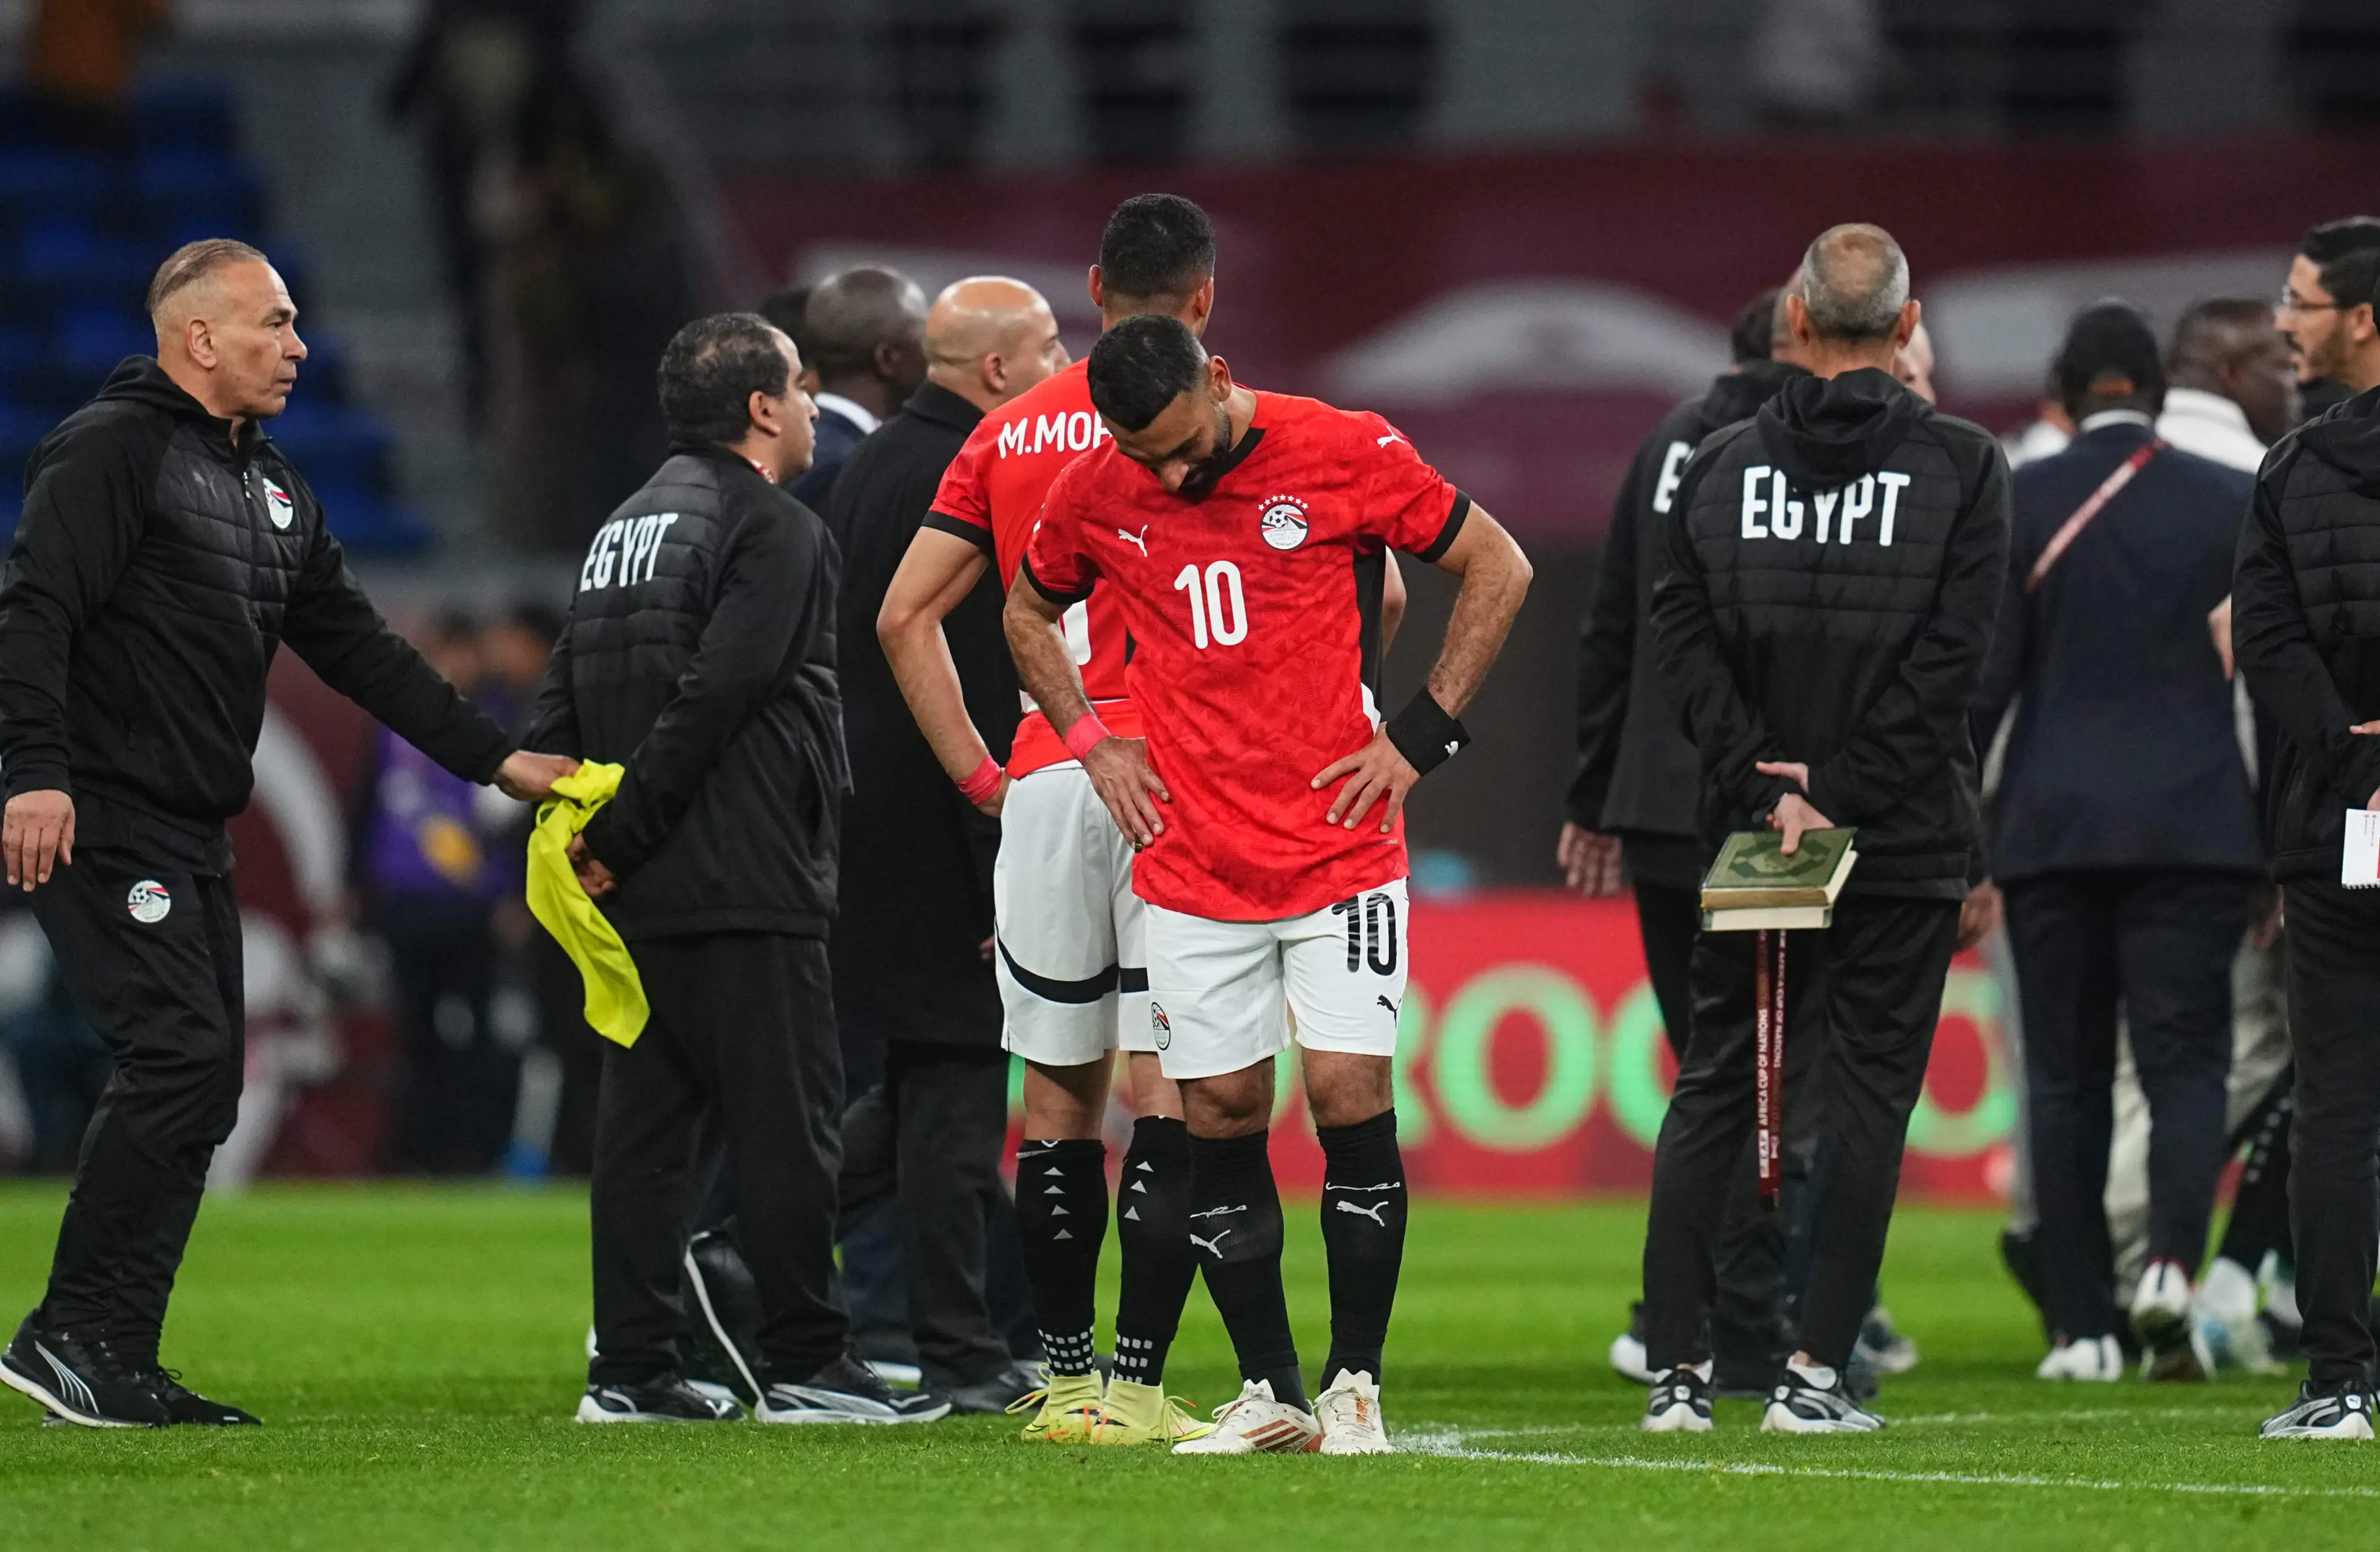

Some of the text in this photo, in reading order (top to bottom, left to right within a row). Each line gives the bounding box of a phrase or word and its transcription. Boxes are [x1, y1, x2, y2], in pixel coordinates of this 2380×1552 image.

[1742, 465, 1911, 546] EGYPT
[580, 512, 678, 592] EGYPT
[1174, 560, 1248, 649] 10
[1331, 893, 1396, 976] 10
[1758, 1008, 1768, 1052] NATIONS
[1758, 1053, 1768, 1067] OF
[1758, 1068, 1768, 1089] CUP
[1758, 1090, 1768, 1126] AFRICA
